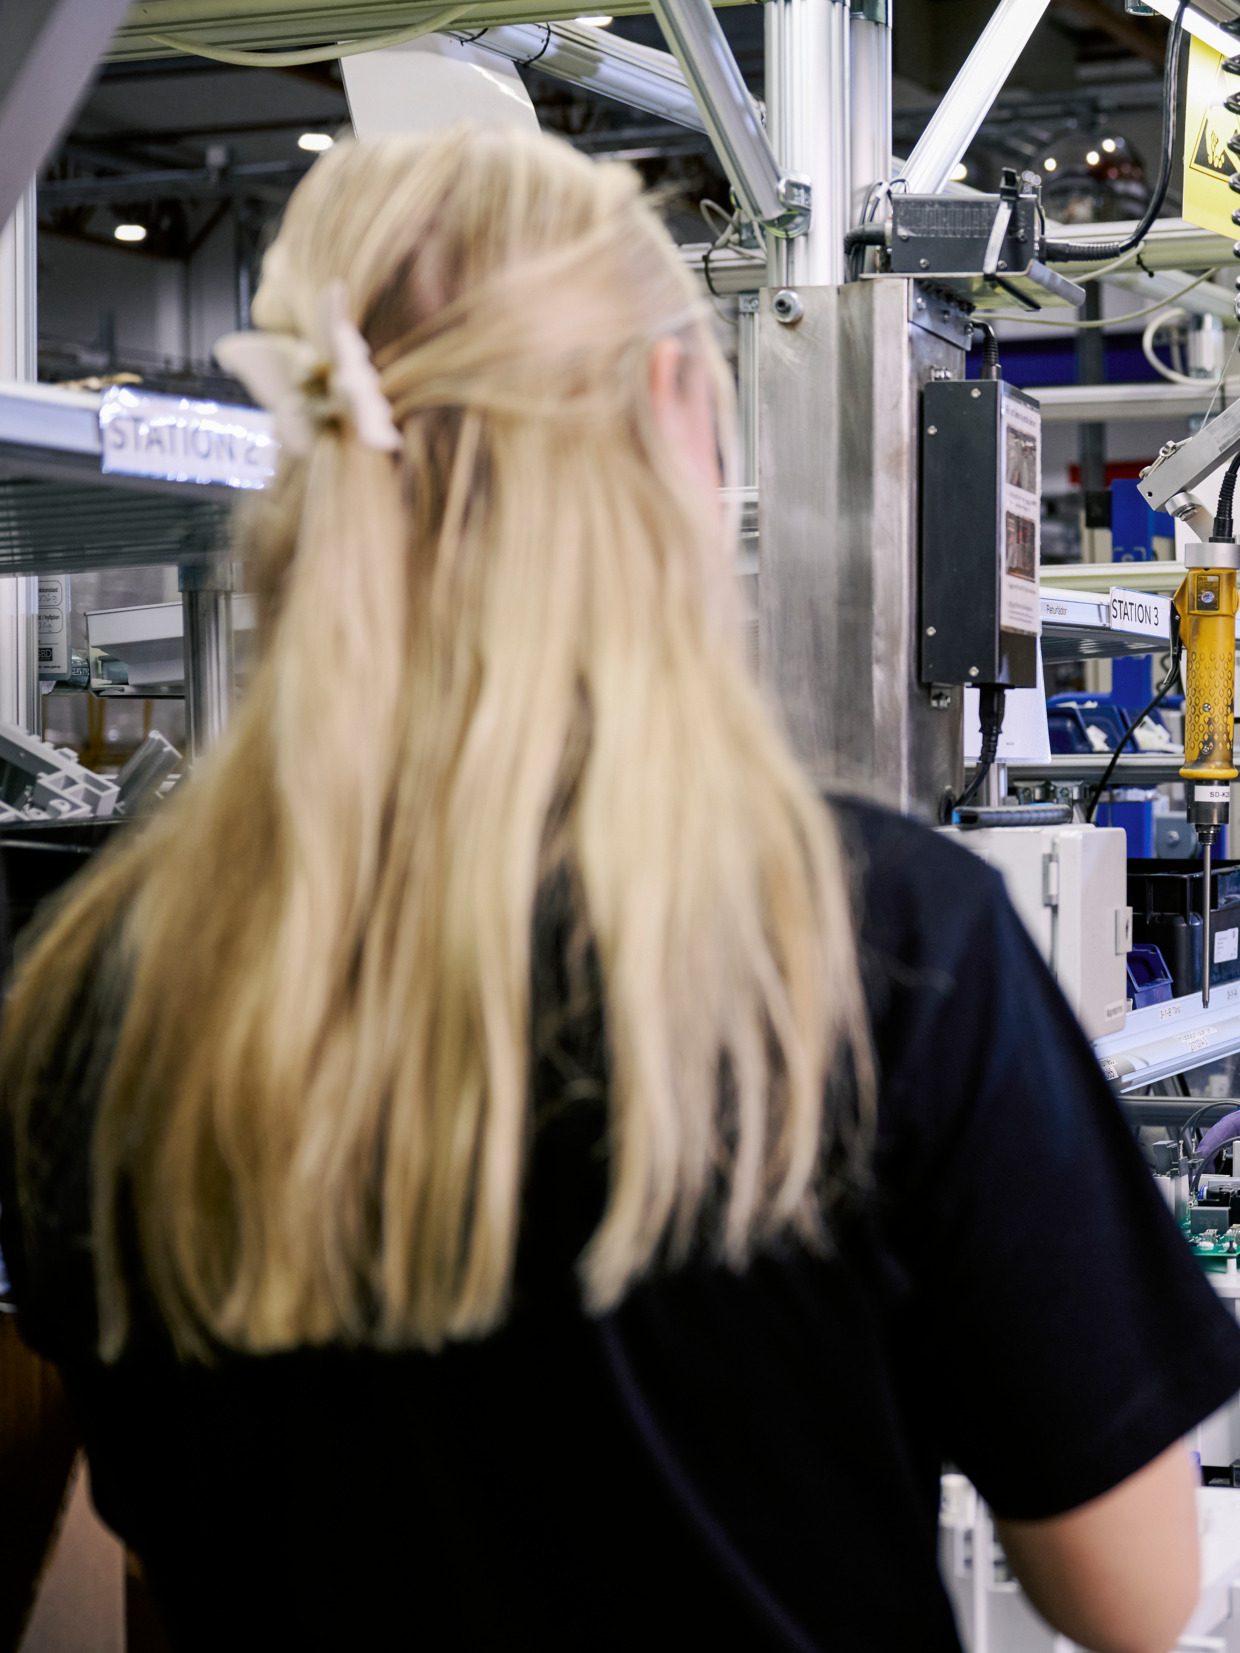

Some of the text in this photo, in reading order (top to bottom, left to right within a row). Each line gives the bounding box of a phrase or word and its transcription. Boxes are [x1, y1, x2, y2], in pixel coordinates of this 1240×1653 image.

[110, 416, 236, 462] STATION
[1111, 599, 1160, 627] STATION 3
